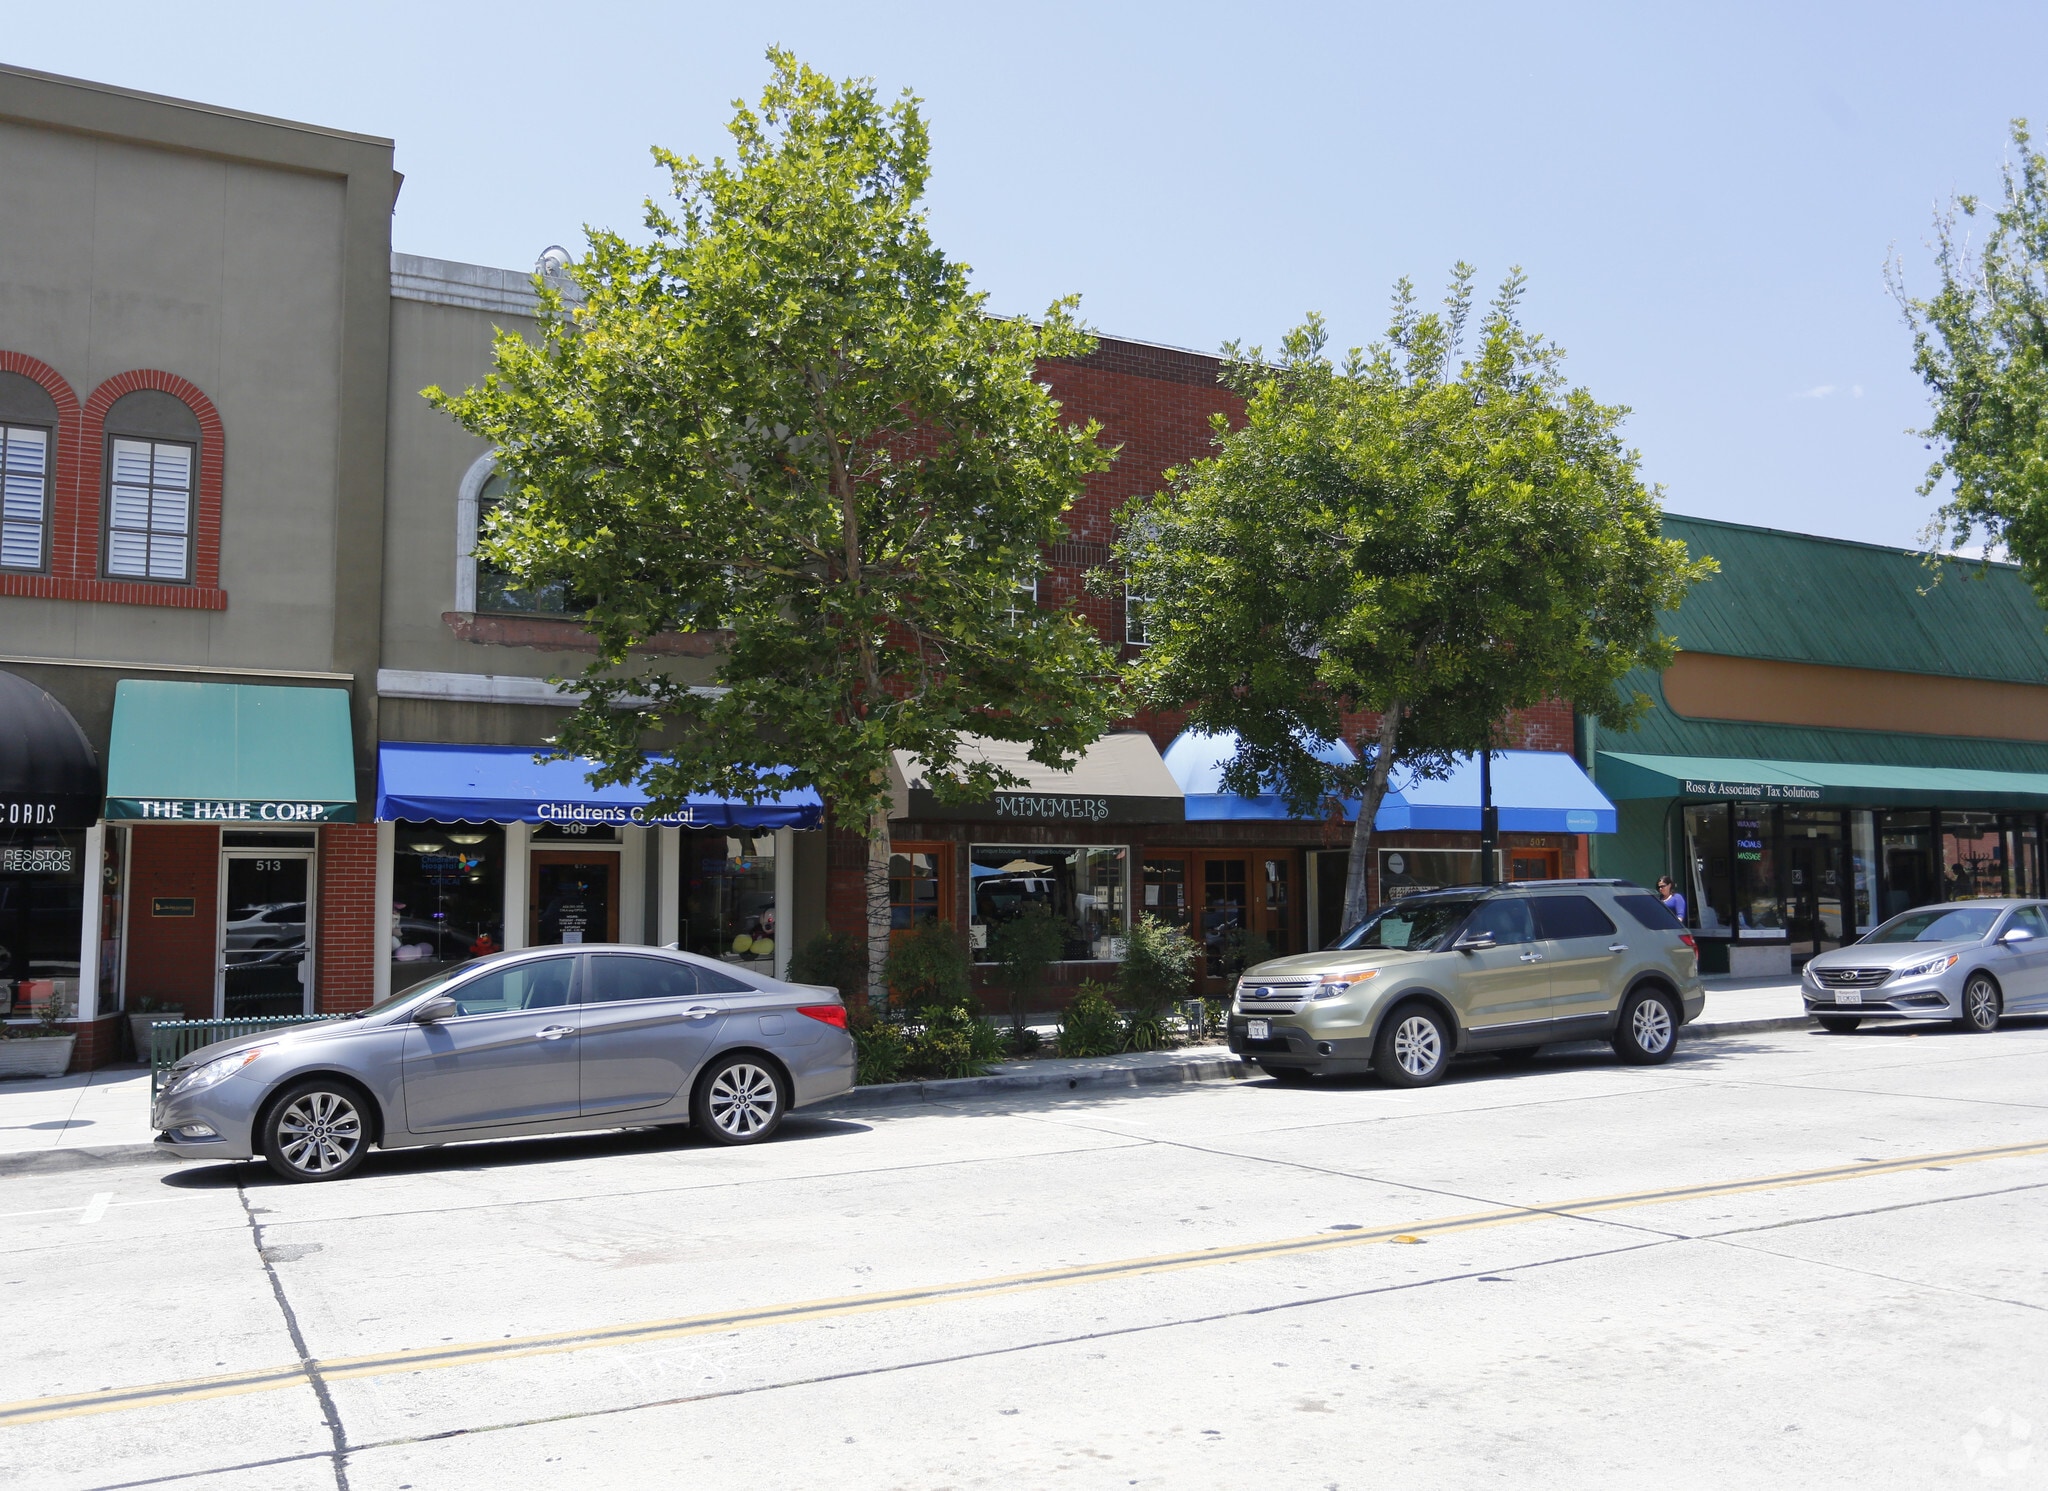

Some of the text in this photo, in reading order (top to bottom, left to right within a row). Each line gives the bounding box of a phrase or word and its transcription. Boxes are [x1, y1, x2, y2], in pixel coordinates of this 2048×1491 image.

[1685, 780, 1706, 794] Ross
[1707, 782, 1716, 794] &
[1766, 785, 1781, 797] Tax
[1782, 786, 1820, 799] Solutions
[139, 801, 329, 821] THE HALE CORP.
[537, 803, 626, 821] Children's
[562, 824, 588, 835] 509
[1530, 837, 1546, 847] 507
[1737, 839, 1762, 849] FACIALS
[4, 850, 72, 861] RESISTOR
[1737, 851, 1762, 861] MASSAGE
[3, 860, 71, 871] RECORDS
[256, 860, 281, 871] 513
